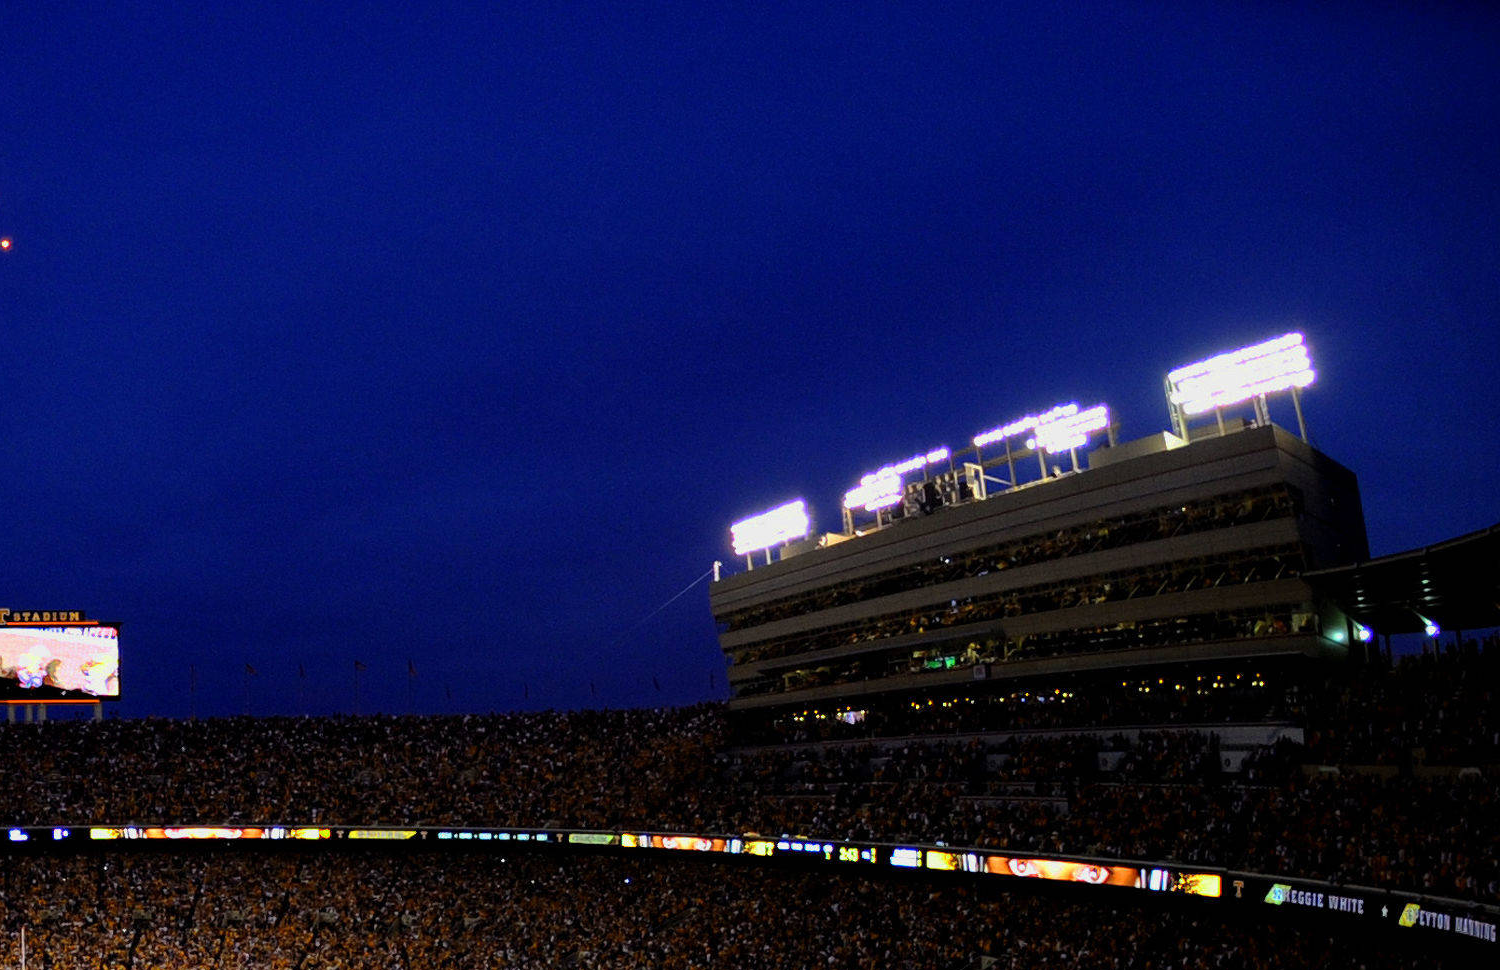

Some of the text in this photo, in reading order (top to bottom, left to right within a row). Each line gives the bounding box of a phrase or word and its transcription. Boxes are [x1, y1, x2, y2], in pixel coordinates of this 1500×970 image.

[13, 612, 80, 622] STADIUM
[1328, 895, 1364, 914] WHITE
[1455, 916, 1496, 943] MANNING
